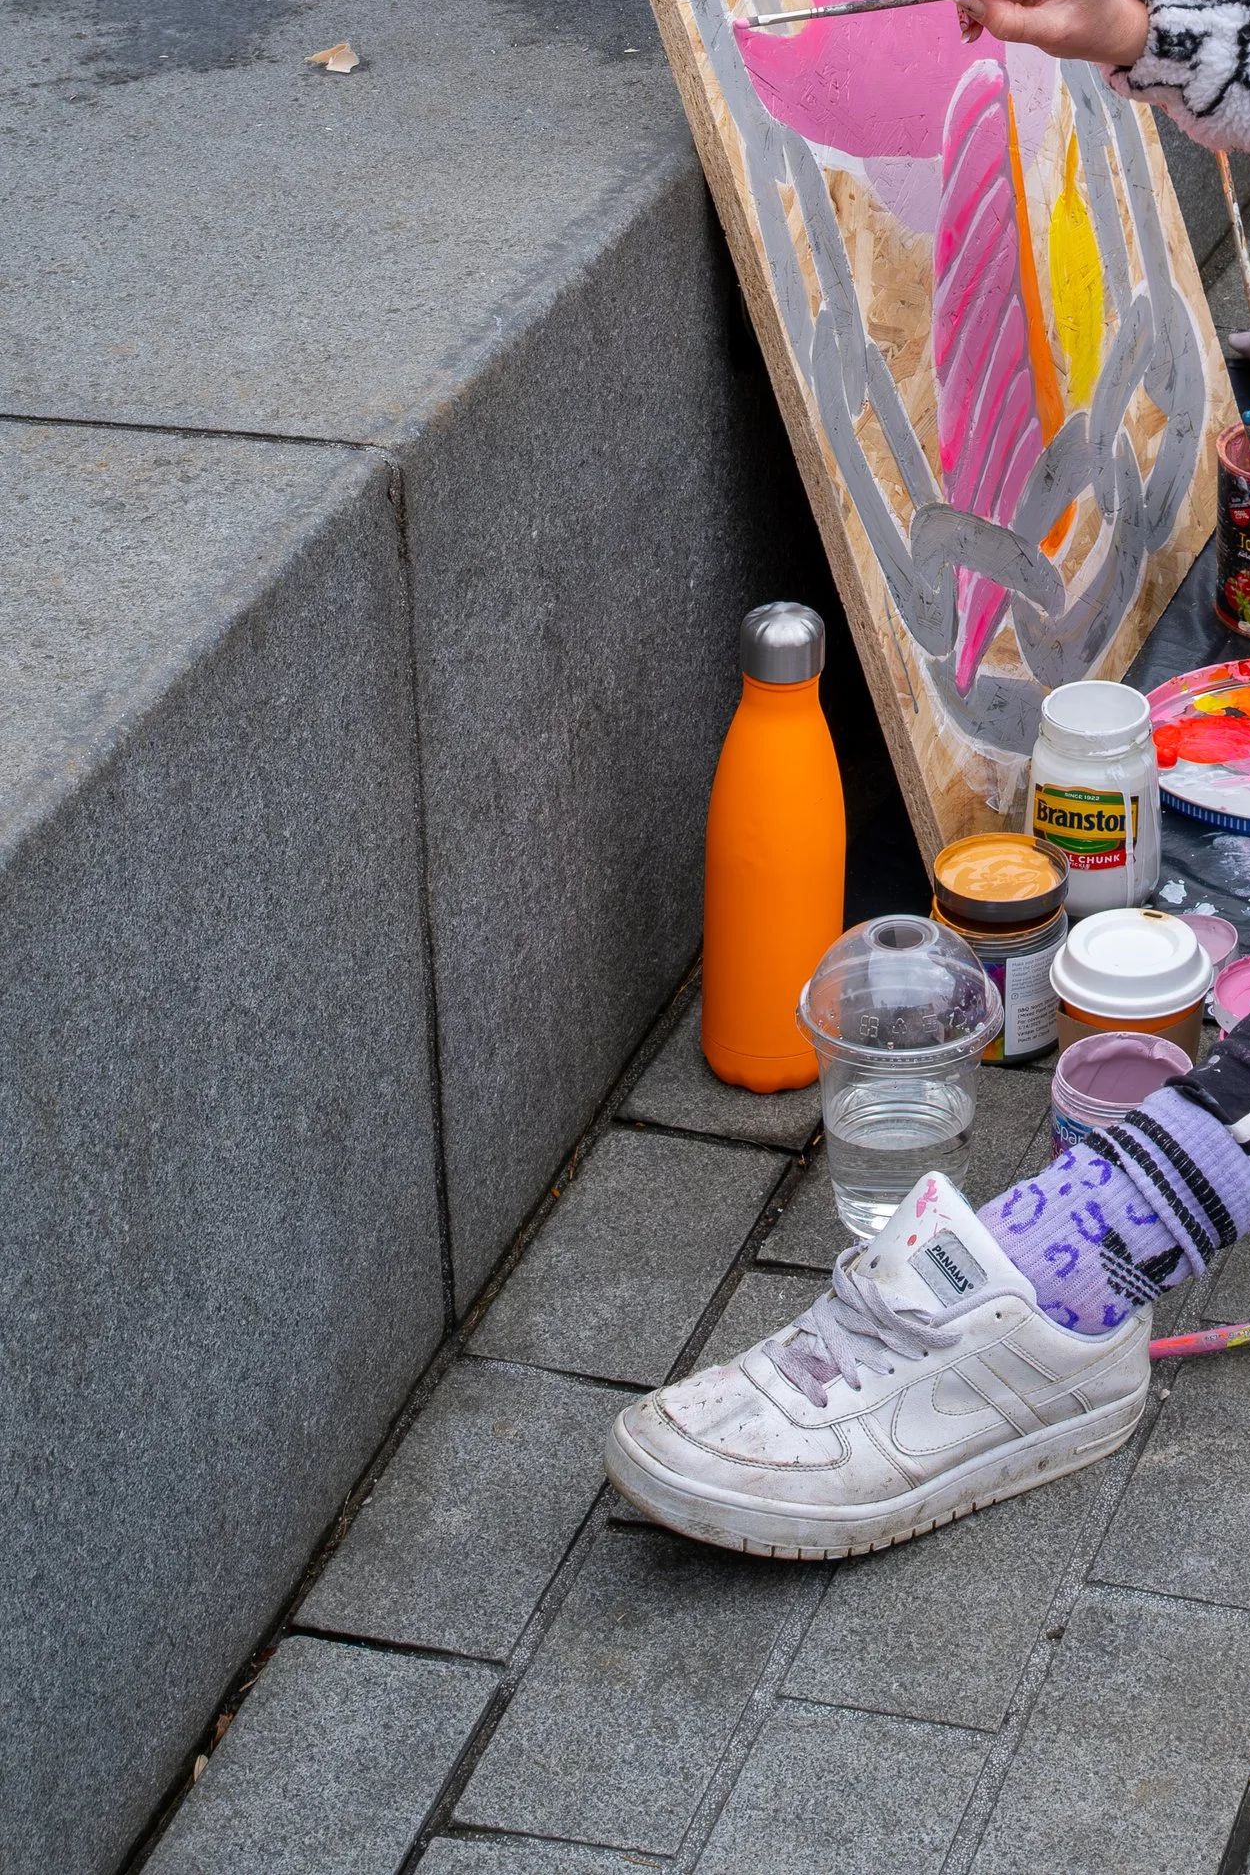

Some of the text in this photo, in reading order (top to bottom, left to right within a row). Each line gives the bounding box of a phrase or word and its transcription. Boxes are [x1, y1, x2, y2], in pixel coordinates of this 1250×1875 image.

[1064, 792, 1083, 800] SINCE
[1078, 854, 1120, 864] CHUNK
[1055, 1121, 1085, 1145] spar
